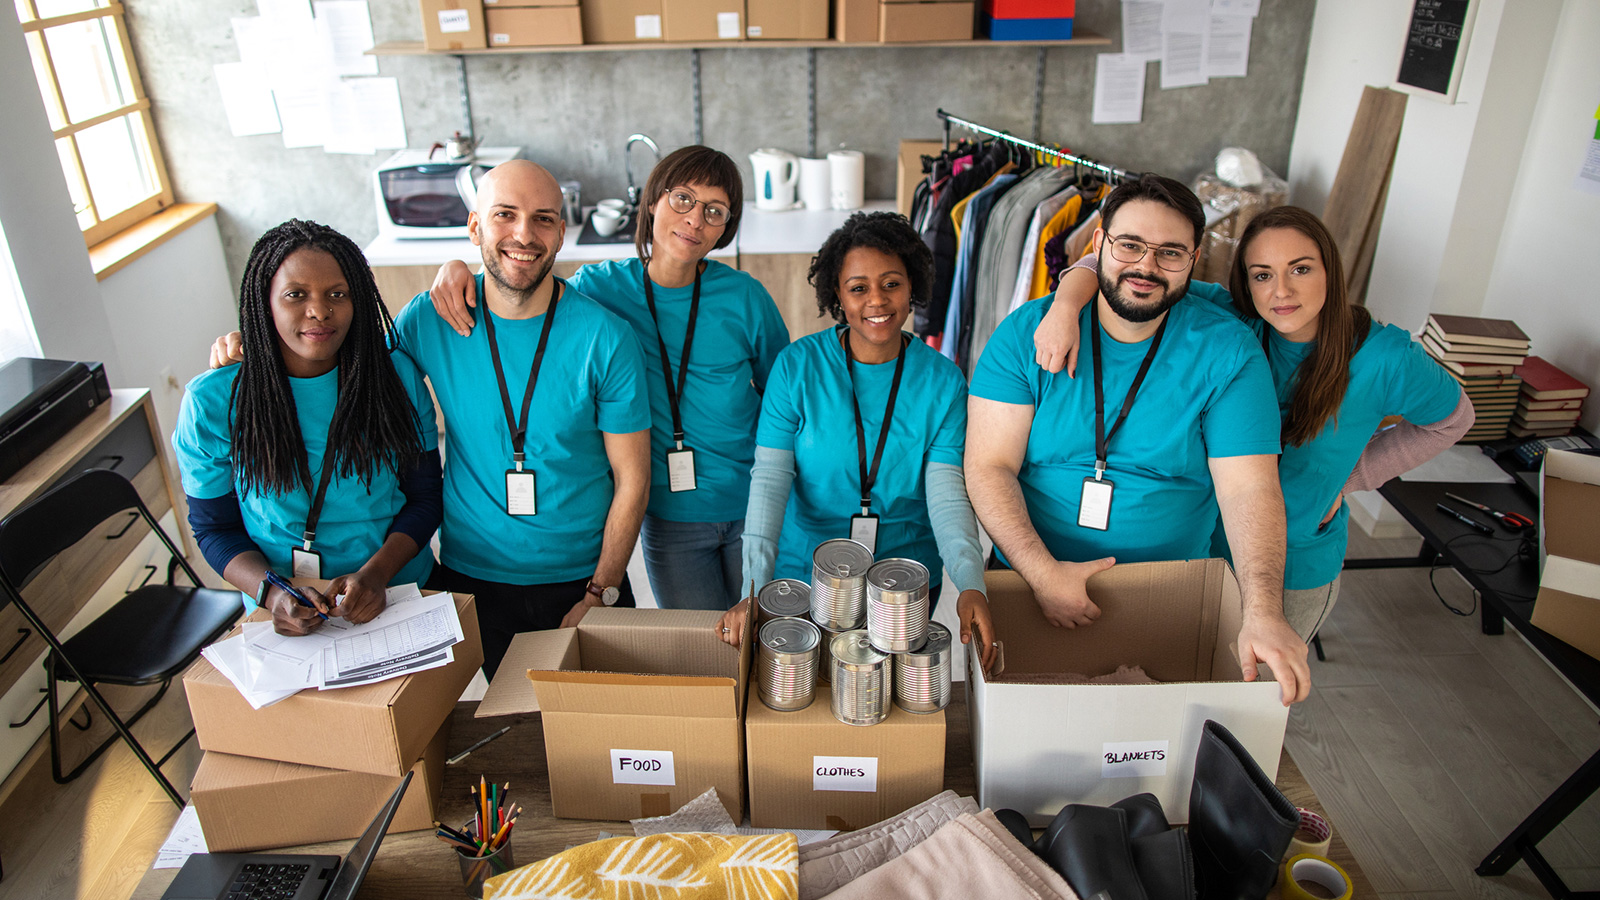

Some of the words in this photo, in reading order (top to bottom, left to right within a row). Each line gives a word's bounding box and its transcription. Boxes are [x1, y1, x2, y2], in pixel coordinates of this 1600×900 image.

[395, 653, 419, 663] Delivery
[383, 665, 408, 675] Delivery
[1104, 750, 1165, 764] BLANKETS
[619, 757, 662, 771] FOOD
[816, 766, 865, 777] CLOTHES
